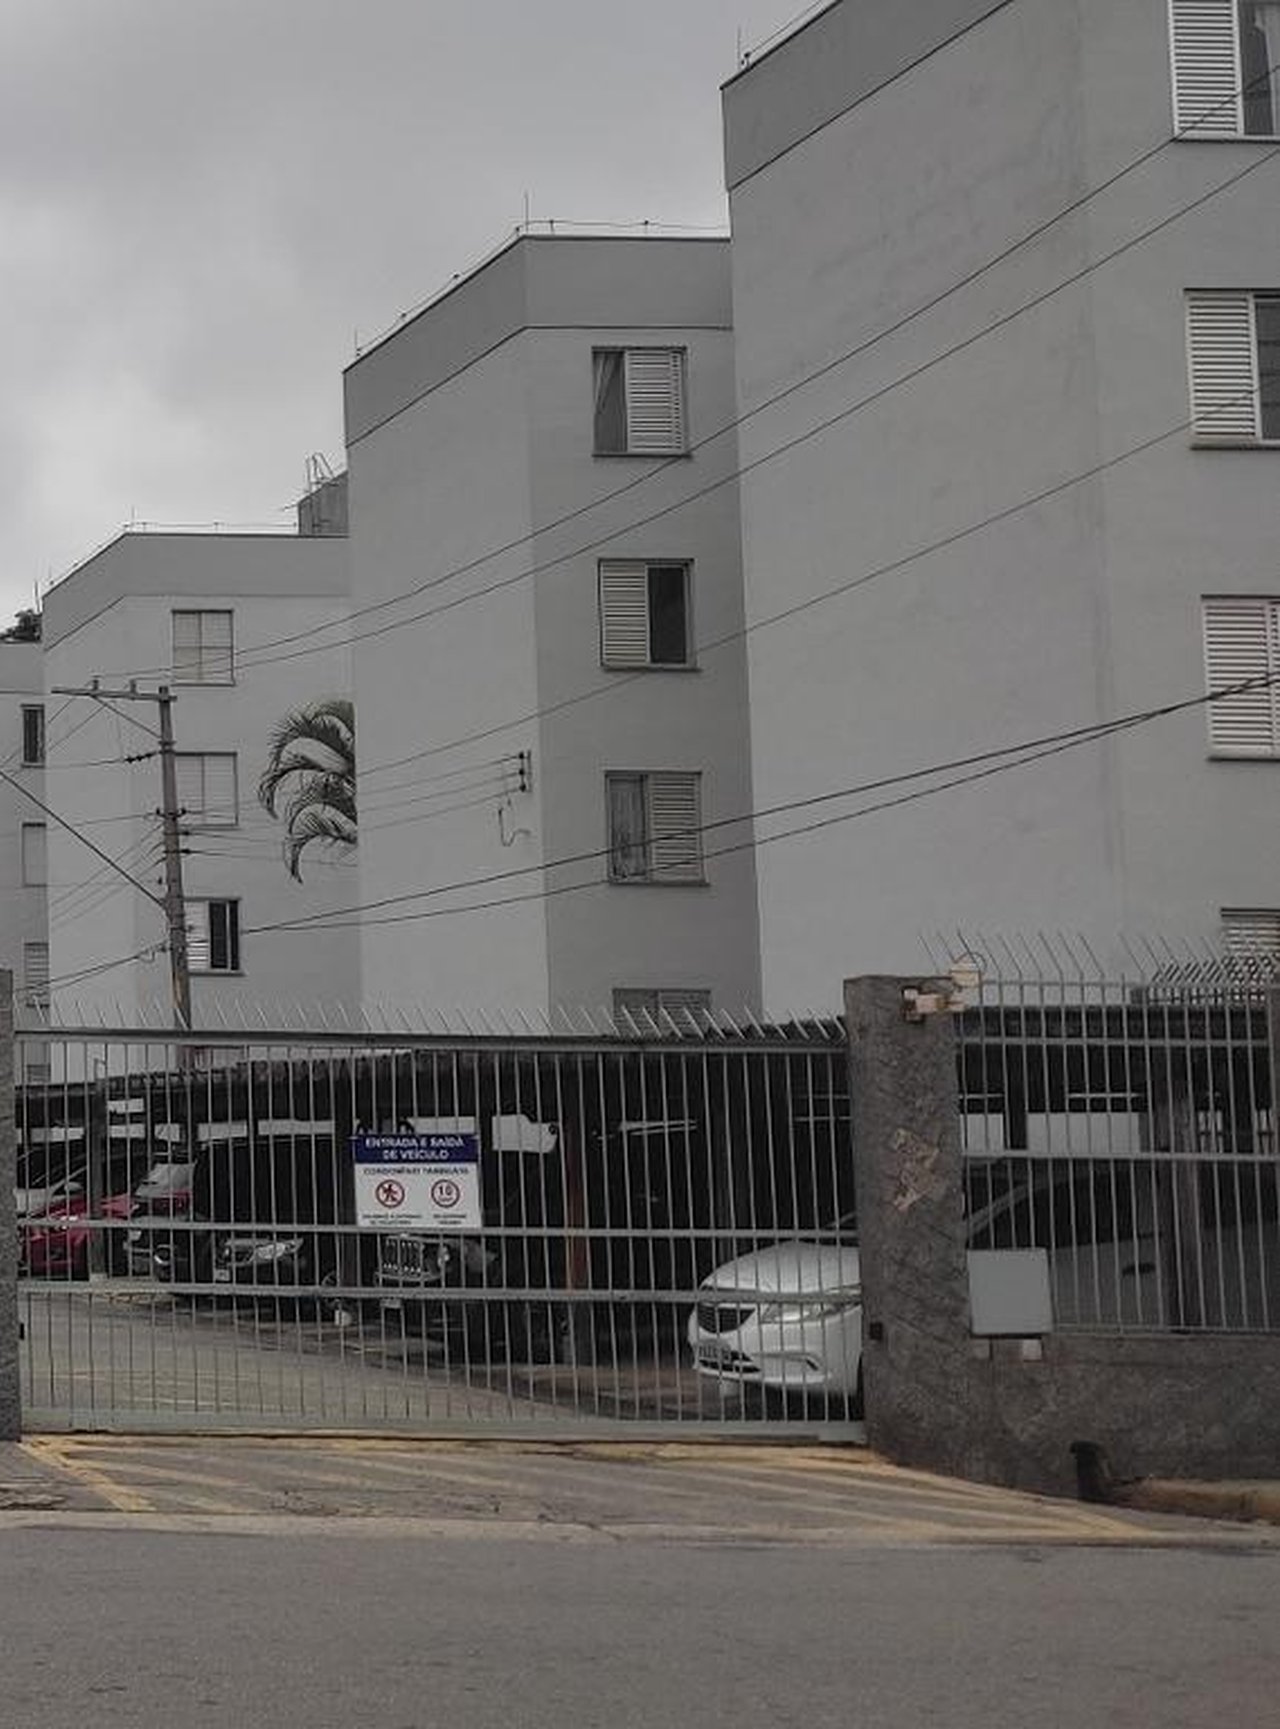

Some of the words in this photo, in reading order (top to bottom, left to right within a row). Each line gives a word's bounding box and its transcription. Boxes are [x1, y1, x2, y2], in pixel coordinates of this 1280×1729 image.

[365, 1137, 418, 1148] ENTRADA
[420, 1137, 427, 1148] E
[383, 1149, 398, 1160] DE
